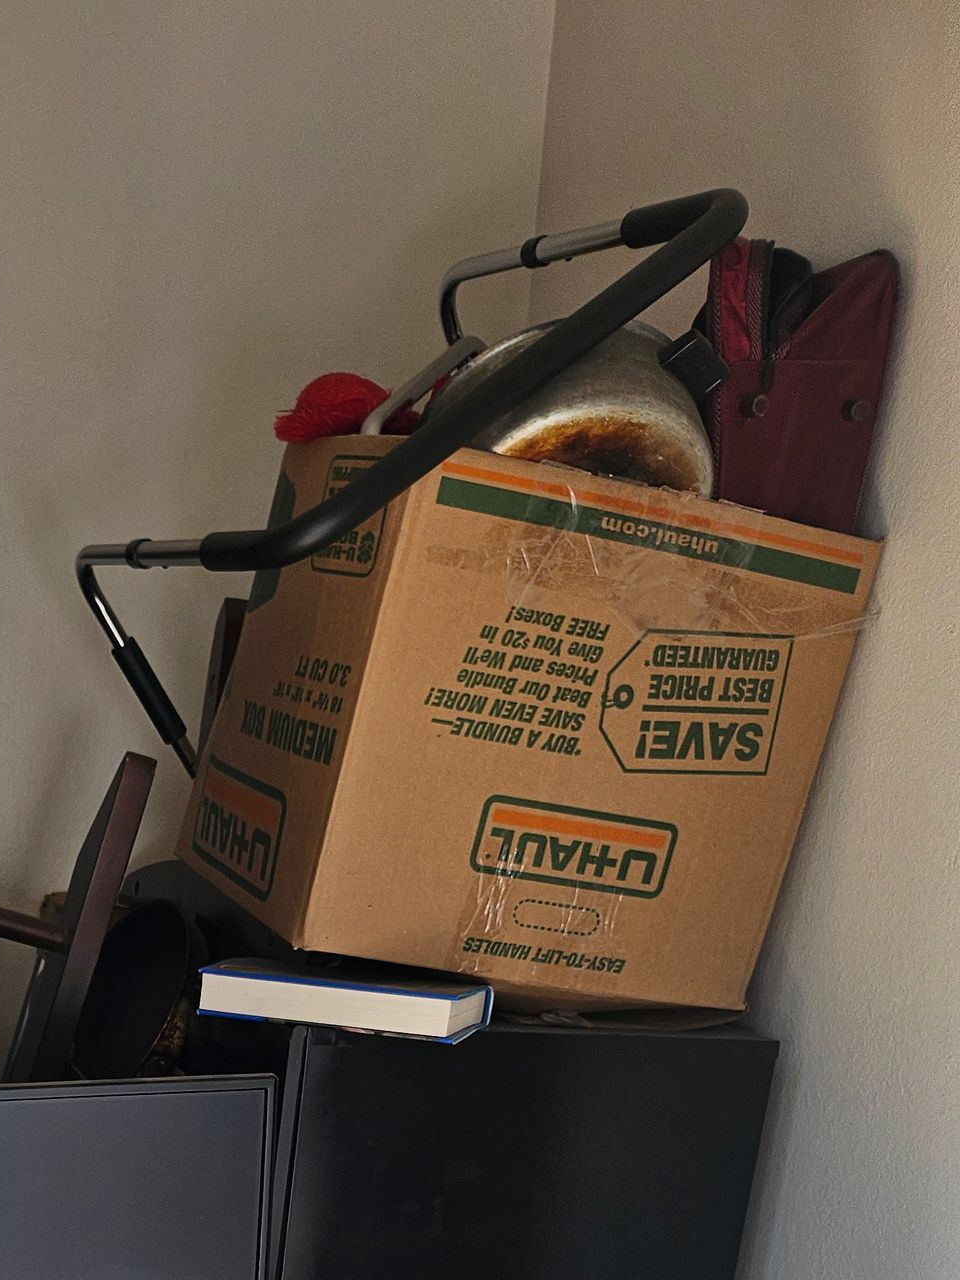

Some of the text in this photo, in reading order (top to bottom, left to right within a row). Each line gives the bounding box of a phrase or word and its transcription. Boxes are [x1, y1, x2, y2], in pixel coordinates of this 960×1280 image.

[601, 516, 719, 554] uhaul.com
[505, 606, 611, 641] FREE Boxes!
[479, 624, 605, 664] Give You $20 in
[294, 655, 352, 688] 3.0 CU FT
[462, 646, 599, 687] Prices and We'll
[456, 668, 593, 709] Beat Our Bundle
[647, 674, 775, 704] BEST PRICE
[424, 687, 587, 732] SAVE EVEN MORE!
[241, 699, 338, 767] MEDIUM BOX
[526, 729, 542, 748] A
[634, 720, 764, 762] SAVE!
[200, 795, 272, 882] U-HAUL
[490, 826, 658, 885] U-HAUL
[462, 937, 627, 974] EASY-TO-LIFT HANDLES
